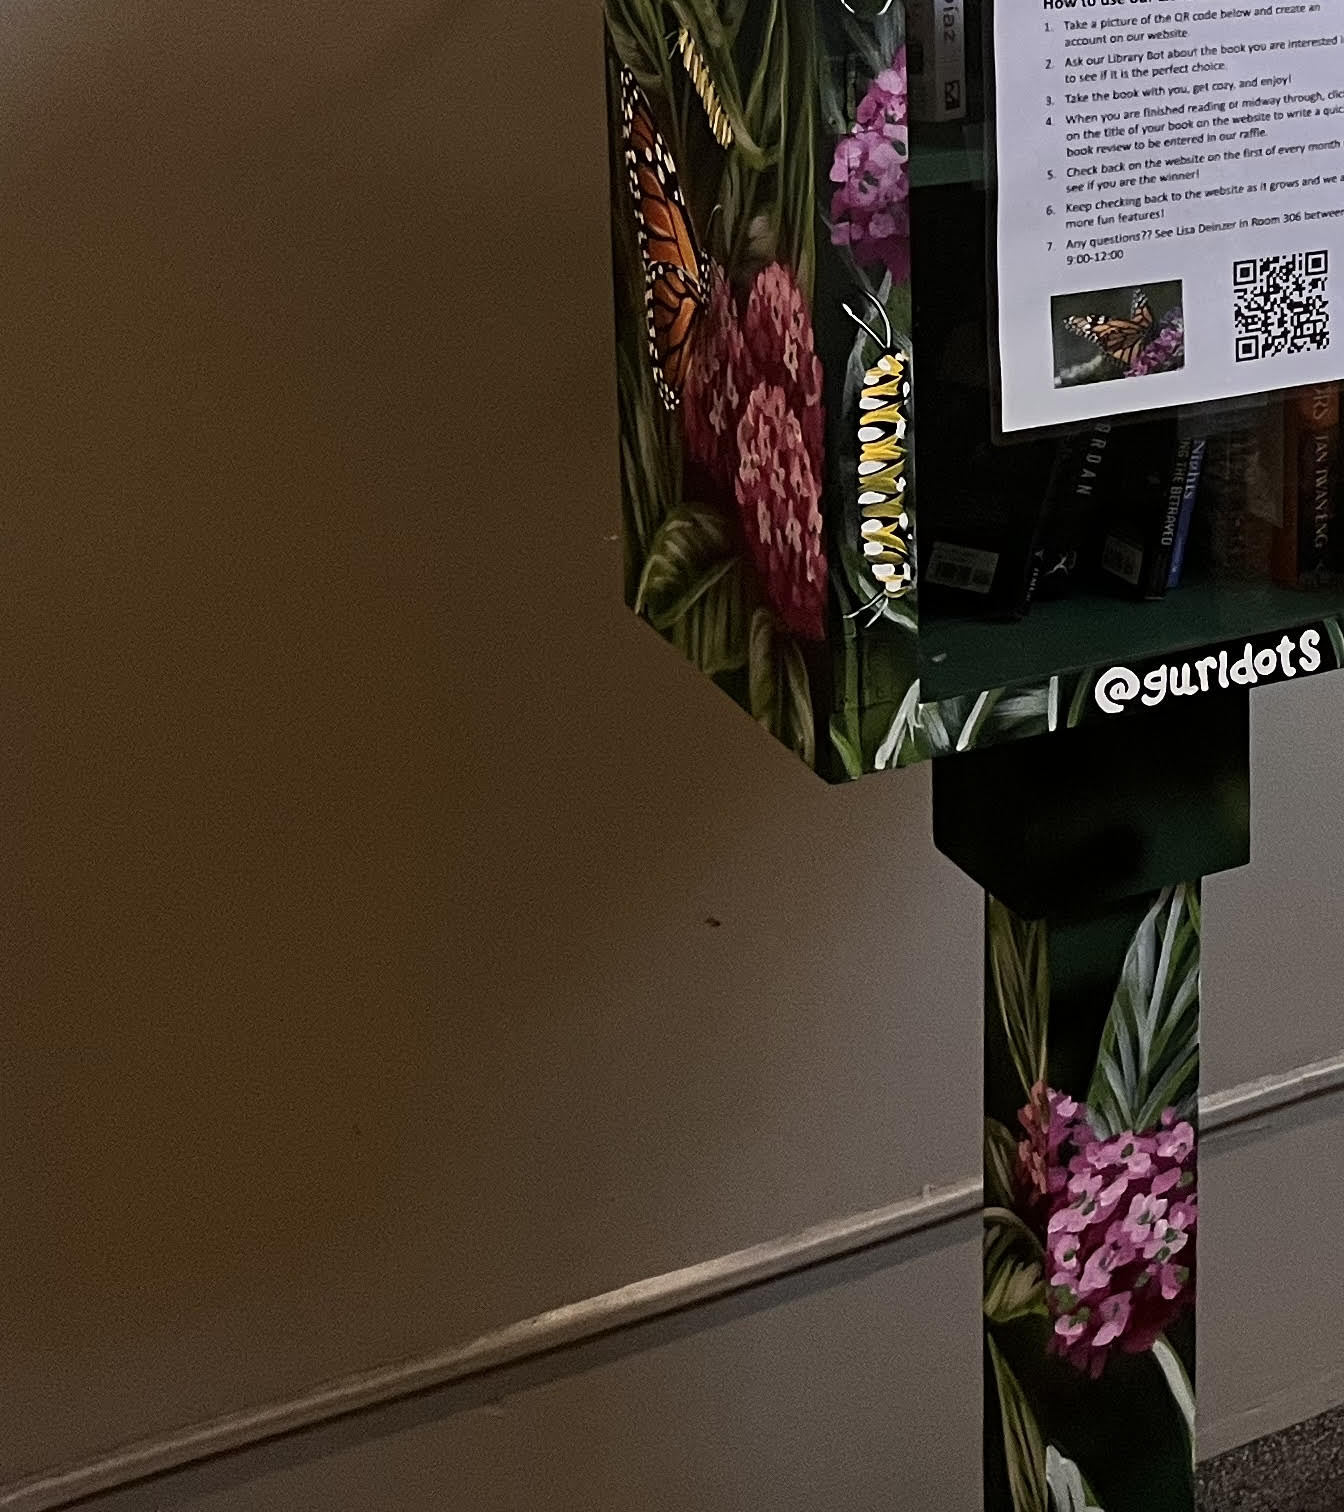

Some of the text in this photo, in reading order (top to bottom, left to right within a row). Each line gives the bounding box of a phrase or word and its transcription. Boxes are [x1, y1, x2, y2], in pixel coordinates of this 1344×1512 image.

[1062, 4, 1306, 30] Take picture of the QR code below and create
[1064, 92, 1088, 104] Take
[1090, 92, 1110, 102] the
[1112, 88, 1138, 100] book
[1140, 86, 1166, 96] with
[1192, 82, 1210, 96] get
[1238, 76, 1258, 88] and
[1066, 164, 1098, 178] Check
[1100, 160, 1126, 174] back
[1128, 162, 1142, 170] on
[1144, 158, 1162, 170] the
[1164, 154, 1206, 166] website
[1206, 152, 1220, 162] on
[1222, 150, 1240, 160] the
[1242, 146, 1262, 158] first
[1264, 144, 1276, 156] of
[1276, 144, 1306, 154] every
[1306, 138, 1340, 150] month
[1064, 182, 1084, 194] see
[1086, 178, 1094, 190] if
[1096, 180, 1116, 192] you
[1118, 176, 1136, 188] are
[1138, 174, 1156, 184] the
[1064, 202, 1092, 212] Keep
[1094, 196, 1142, 210] checking
[1142, 192, 1168, 204] back
[1170, 192, 1182, 202] to
[1184, 190, 1202, 200] the
[1204, 184, 1244, 198] website
[1246, 184, 1258, 192] as
[1258, 182, 1266, 190] it
[1268, 178, 1300, 192] grows
[1300, 174, 1320, 186] and
[1322, 174, 1338, 184] we
[1064, 218, 1094, 228] more
[1096, 214, 1114, 226] fun
[1066, 238, 1088, 250] Any
[1088, 228, 1152, 248] questions??
[1154, 228, 1174, 238] See
[1238, 218, 1248, 228] in
[1250, 216, 1280, 226] Room
[1282, 210, 1302, 224] 306
[1173, 458, 1189, 483] THE
[1160, 485, 1184, 546] BETRAYED
[1094, 629, 1323, 715] @gurldots
